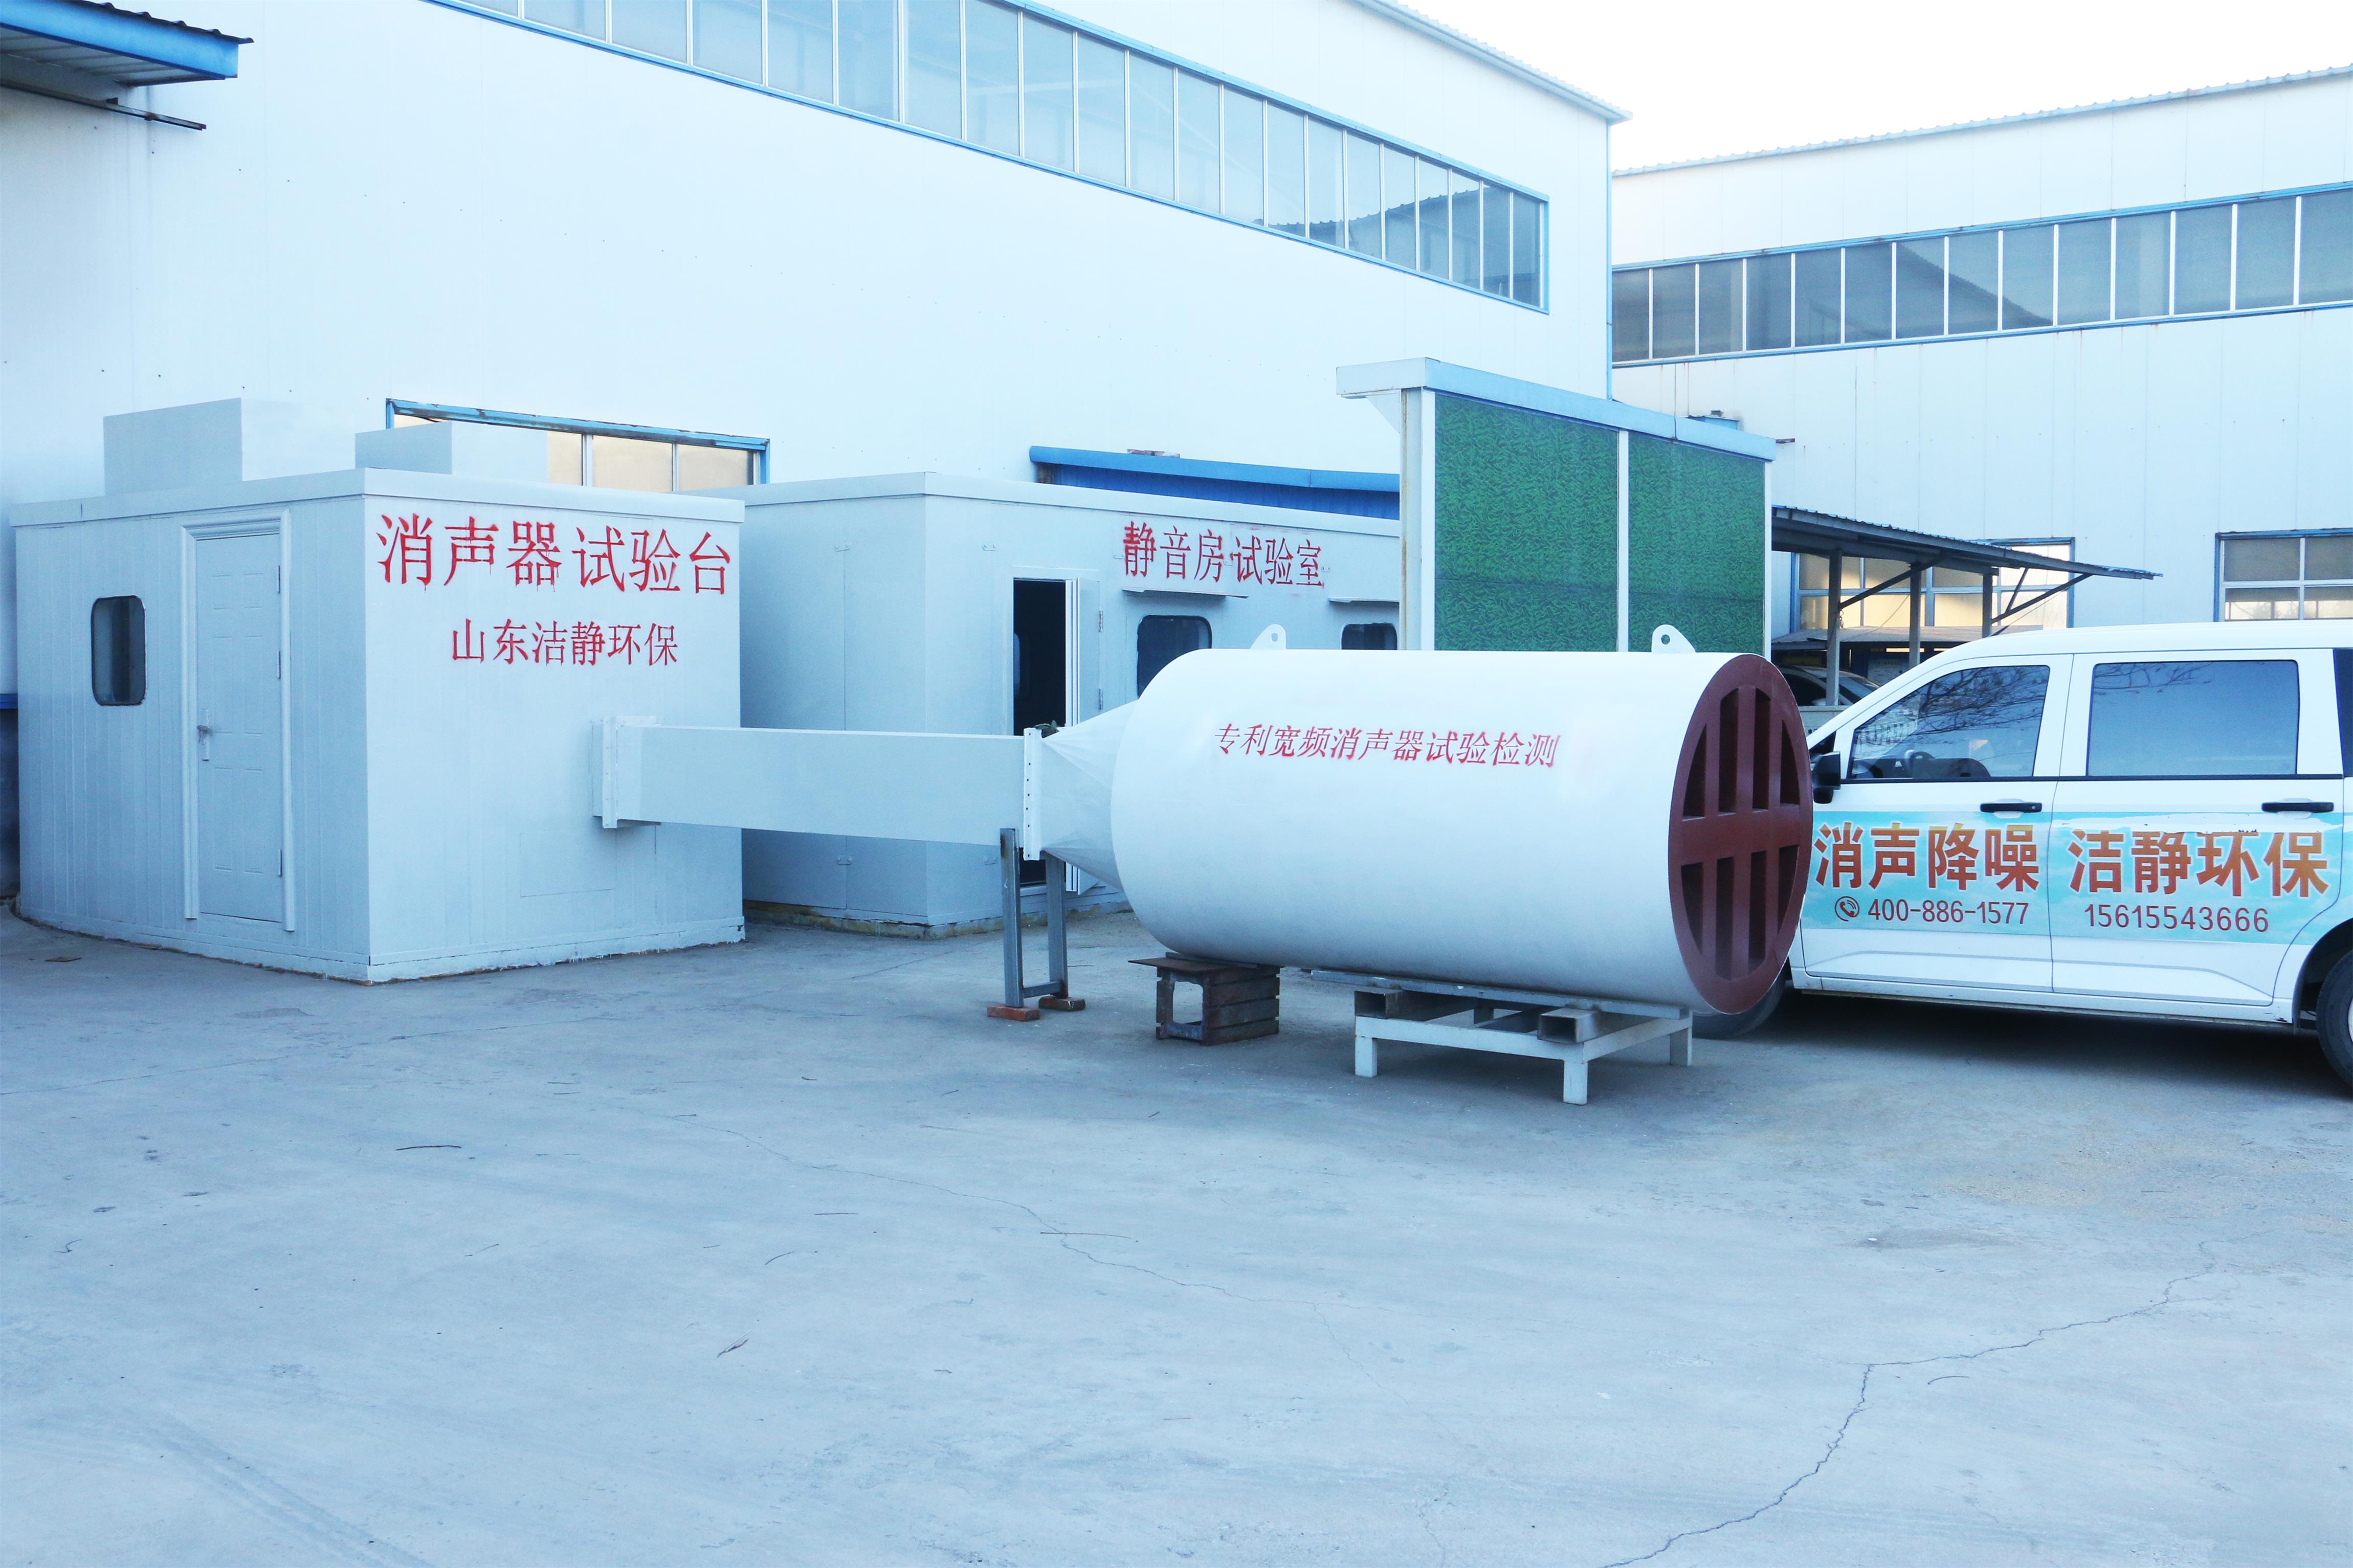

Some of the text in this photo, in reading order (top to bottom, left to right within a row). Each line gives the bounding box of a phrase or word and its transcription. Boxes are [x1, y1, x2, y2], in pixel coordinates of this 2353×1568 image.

[377, 513, 730, 595] 消声器试验台
[1123, 521, 1323, 587] 静音房试验室
[452, 618, 678, 666] 山东洁静环保
[1215, 723, 1561, 768] 专利宽频消声器试验检测
[1814, 822, 2039, 892] 消声降噪
[2068, 830, 2328, 897] 洁静环保
[1868, 899, 2029, 925] 400-886-1577
[2084, 904, 2269, 932] 15615543666
